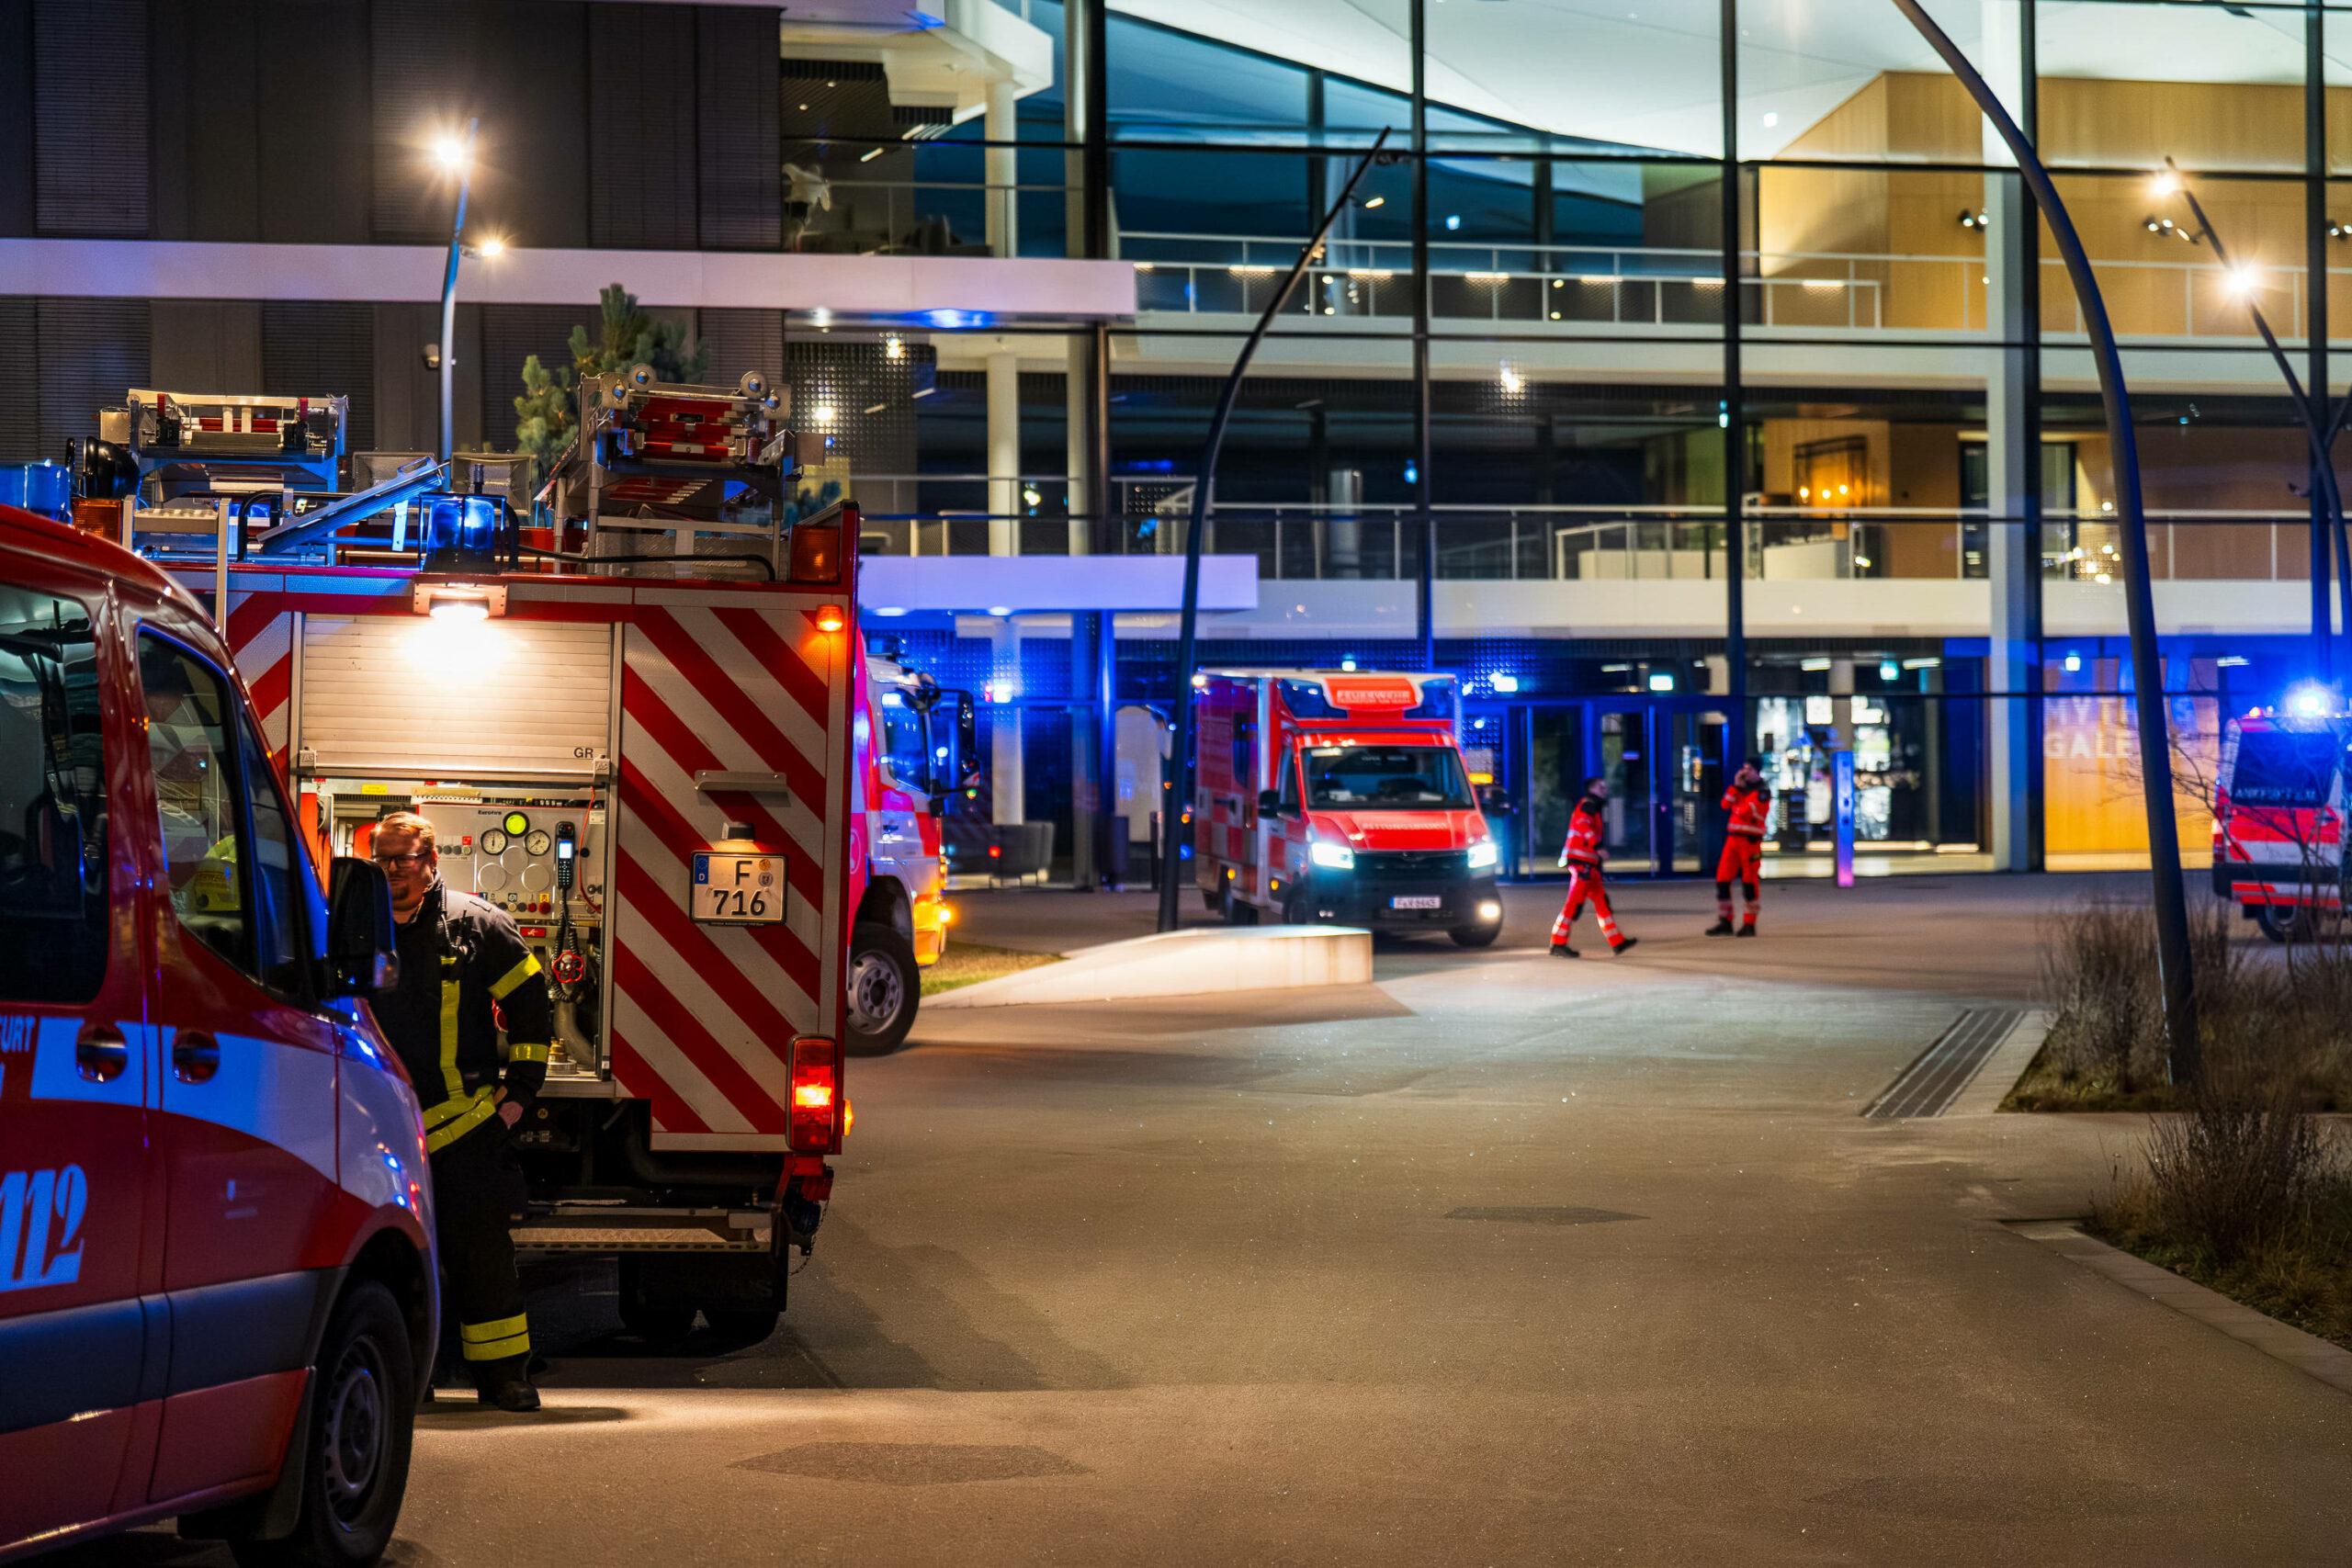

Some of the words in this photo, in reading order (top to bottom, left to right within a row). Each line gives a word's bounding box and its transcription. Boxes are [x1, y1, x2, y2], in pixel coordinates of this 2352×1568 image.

[1336, 690, 1411, 699] FEUERWEHR
[573, 747, 594, 759] GR
[698, 873, 706, 882] D
[735, 860, 752, 886] F
[713, 889, 765, 916] 716
